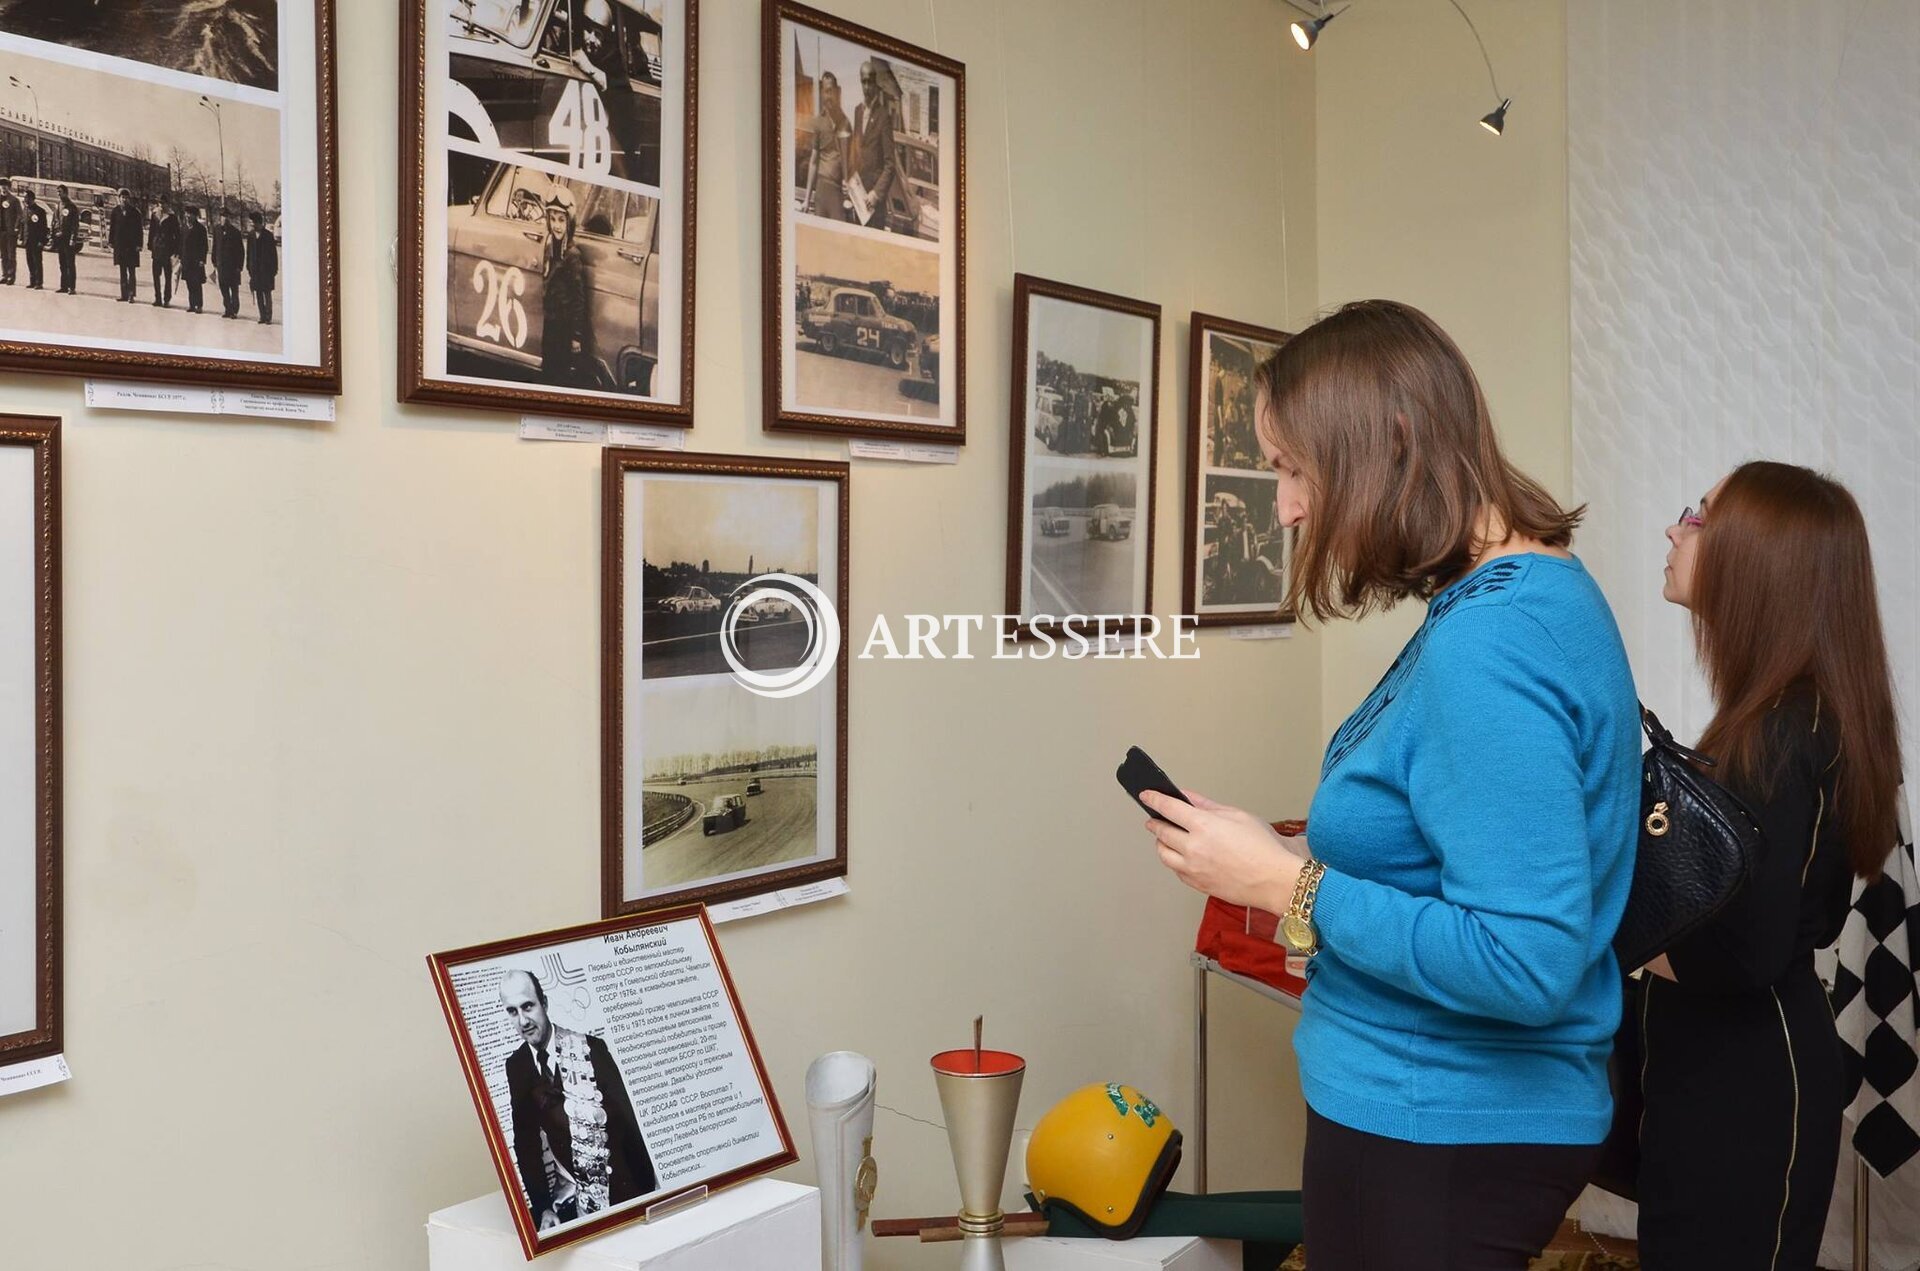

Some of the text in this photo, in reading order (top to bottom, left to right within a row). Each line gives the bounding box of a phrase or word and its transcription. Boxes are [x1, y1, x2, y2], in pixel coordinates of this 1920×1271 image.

[549, 79, 611, 176] 48
[473, 259, 528, 349] 26
[857, 326, 880, 348] 24
[604, 926, 668, 944] Иван Андреевич
[614, 937, 667, 955] Кобылянский
